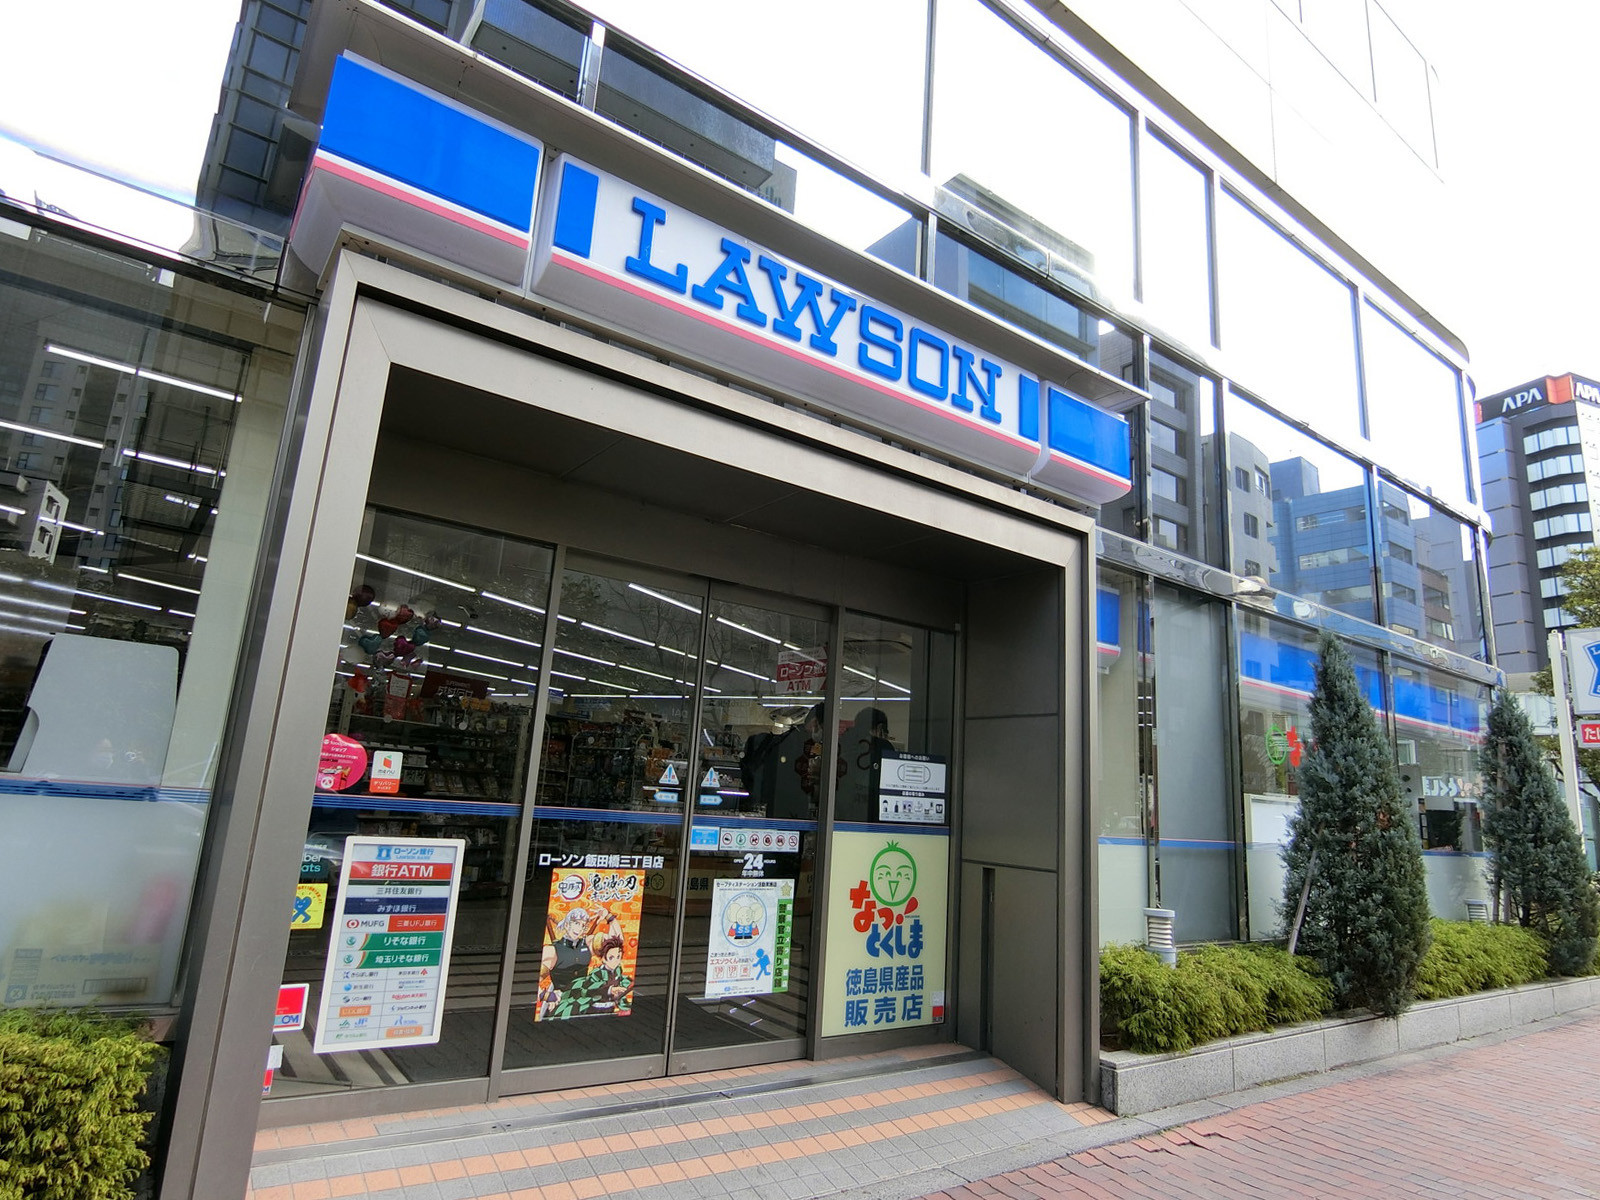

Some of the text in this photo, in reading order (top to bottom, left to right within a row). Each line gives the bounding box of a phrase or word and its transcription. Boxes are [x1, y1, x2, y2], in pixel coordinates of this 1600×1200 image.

[625, 196, 1003, 425] LAWSON
[1501, 387, 1543, 413] APA
[787, 680, 812, 692] ATM
[302, 852, 321, 863] ber
[743, 853, 764, 870] 24
[301, 864, 321, 873] ats
[371, 864, 434, 878] 銀行ATM
[687, 877, 709, 891] 島県
[376, 887, 423, 895] 三井住友銀行
[590, 891, 634, 902] キャンペーン
[361, 920, 385, 928] MUFG
[737, 926, 751, 934] SS
[383, 936, 427, 946] りそな銀行
[866, 919, 924, 960] とくしま
[375, 954, 430, 964] 埼玉りそな銀行
[845, 965, 924, 997] 徳島県産品
[844, 994, 924, 1028] 販売店
